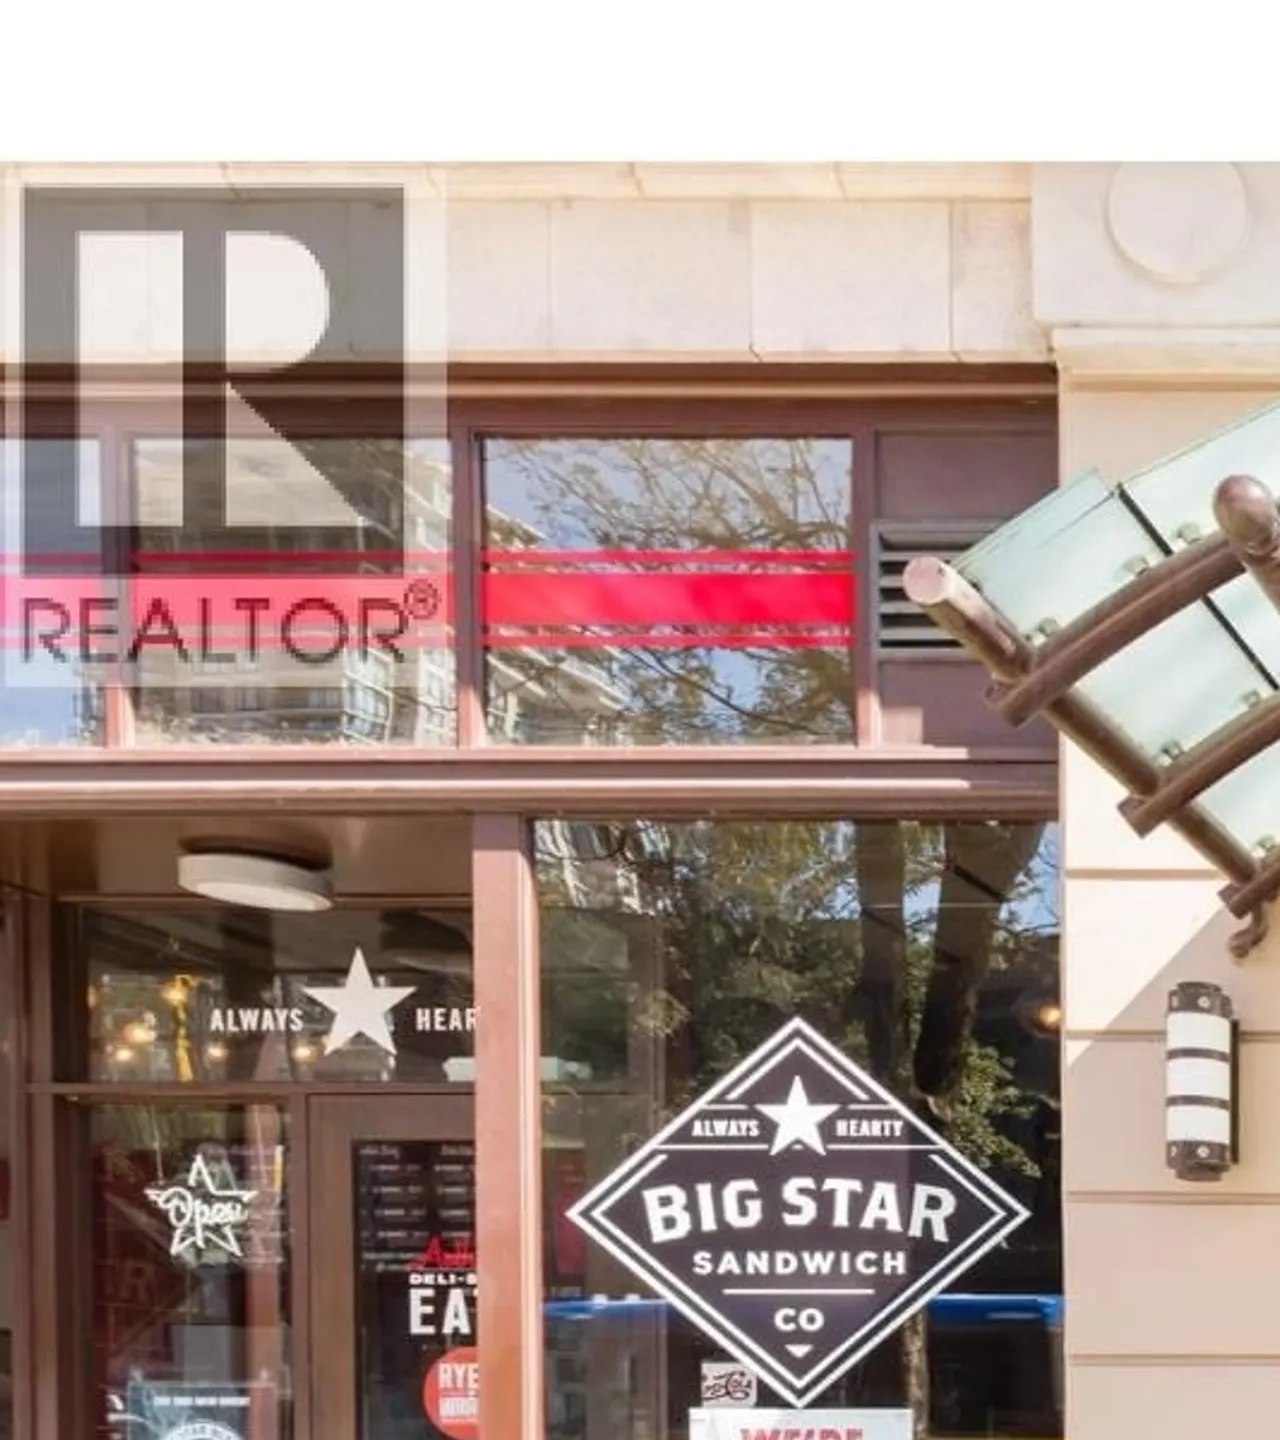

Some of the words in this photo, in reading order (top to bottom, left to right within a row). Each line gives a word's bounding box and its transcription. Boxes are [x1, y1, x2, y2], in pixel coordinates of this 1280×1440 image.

[210, 1008, 304, 1031] ALWAYS
[692, 1119, 760, 1138] ALWAYS
[836, 1119, 903, 1138] HEARTY
[157, 1186, 249, 1249] Open
[642, 1177, 763, 1243] BIG
[781, 1176, 958, 1243] STAR
[693, 1251, 906, 1276] SANDWICH
[410, 1288, 479, 1335] EA
[773, 1307, 825, 1333] CO
